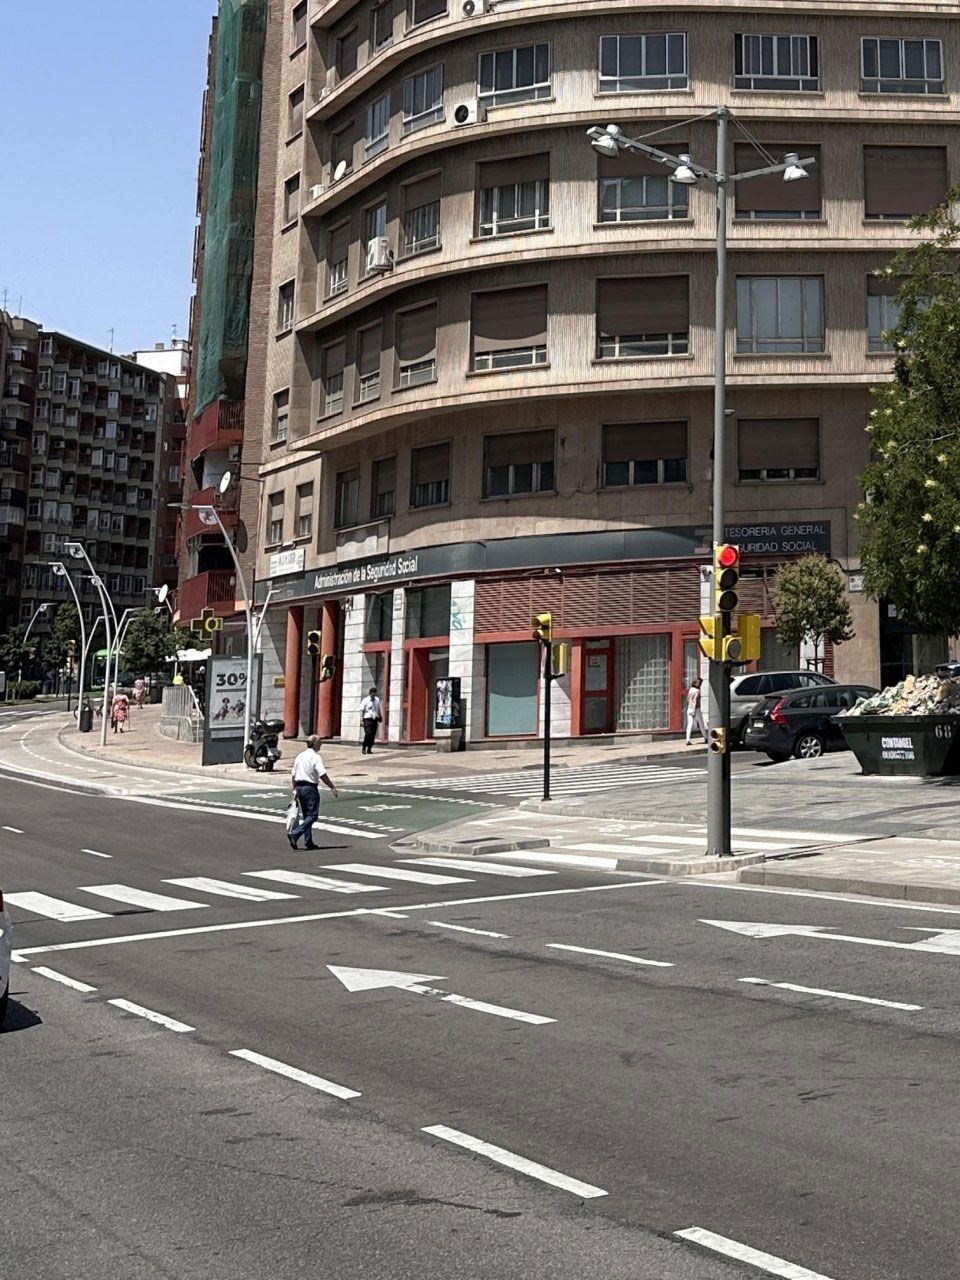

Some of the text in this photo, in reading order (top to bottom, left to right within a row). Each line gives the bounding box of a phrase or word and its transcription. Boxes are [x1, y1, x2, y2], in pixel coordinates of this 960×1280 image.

[781, 525, 826, 536] GENERAL
[738, 541, 817, 552] GURIDAD SOCIAL
[314, 555, 418, 589] Administración de la Seguridad Social
[935, 724, 952, 739] 68
